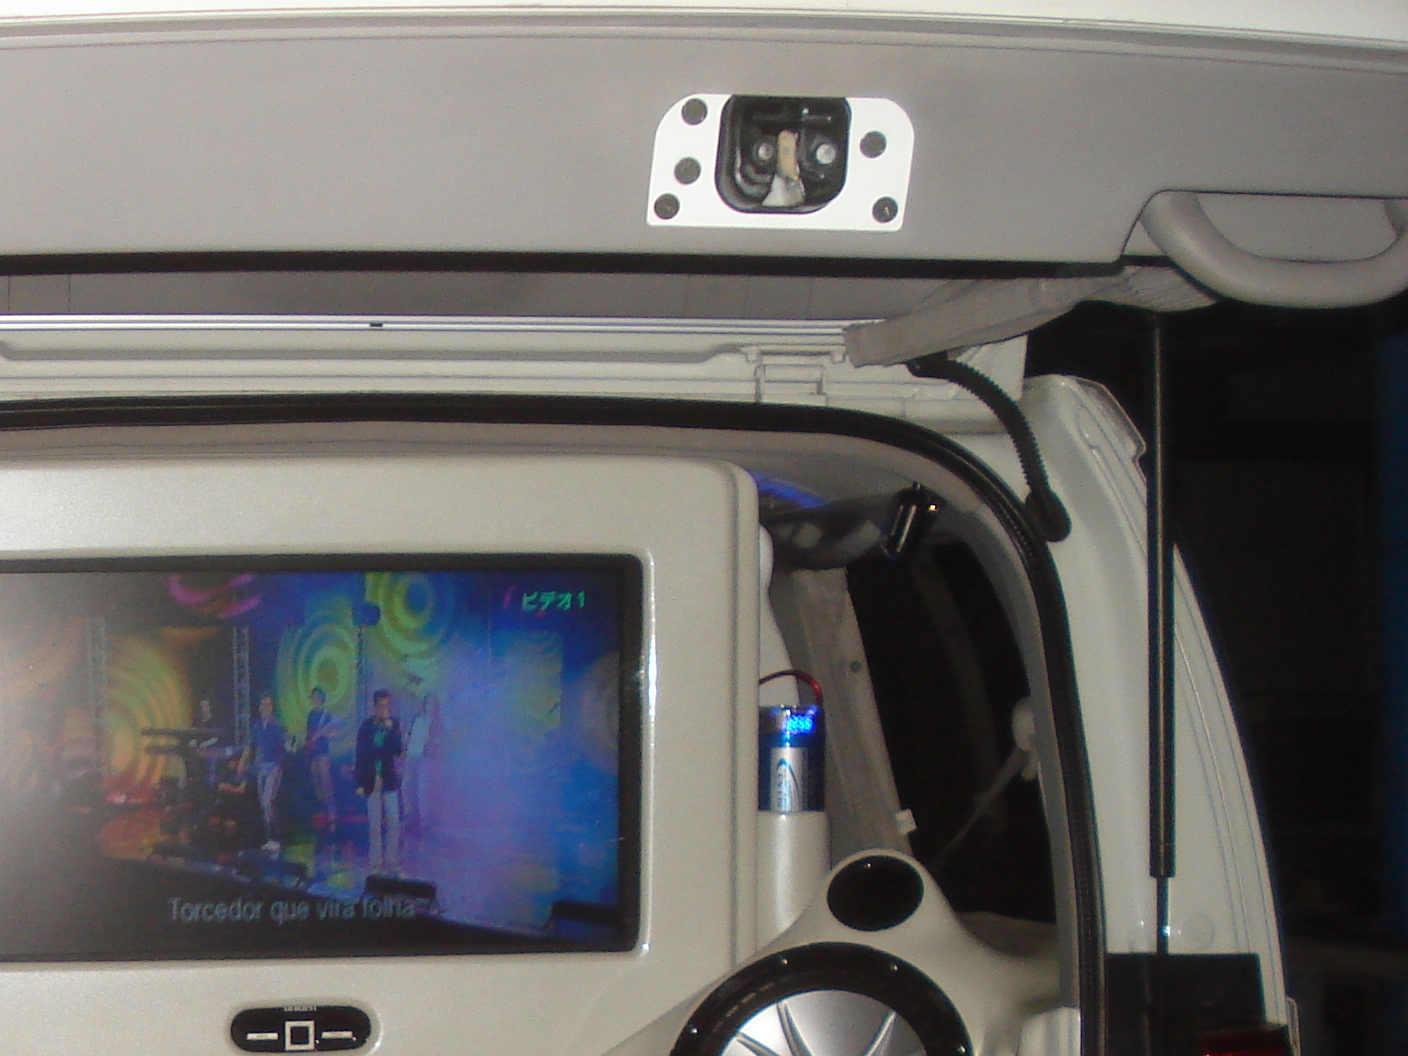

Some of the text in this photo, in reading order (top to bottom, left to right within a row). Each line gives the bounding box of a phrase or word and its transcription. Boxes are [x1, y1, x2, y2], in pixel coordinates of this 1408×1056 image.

[168, 897, 263, 923] Torcedor
[269, 900, 310, 926] que
[315, 897, 355, 920] vira
